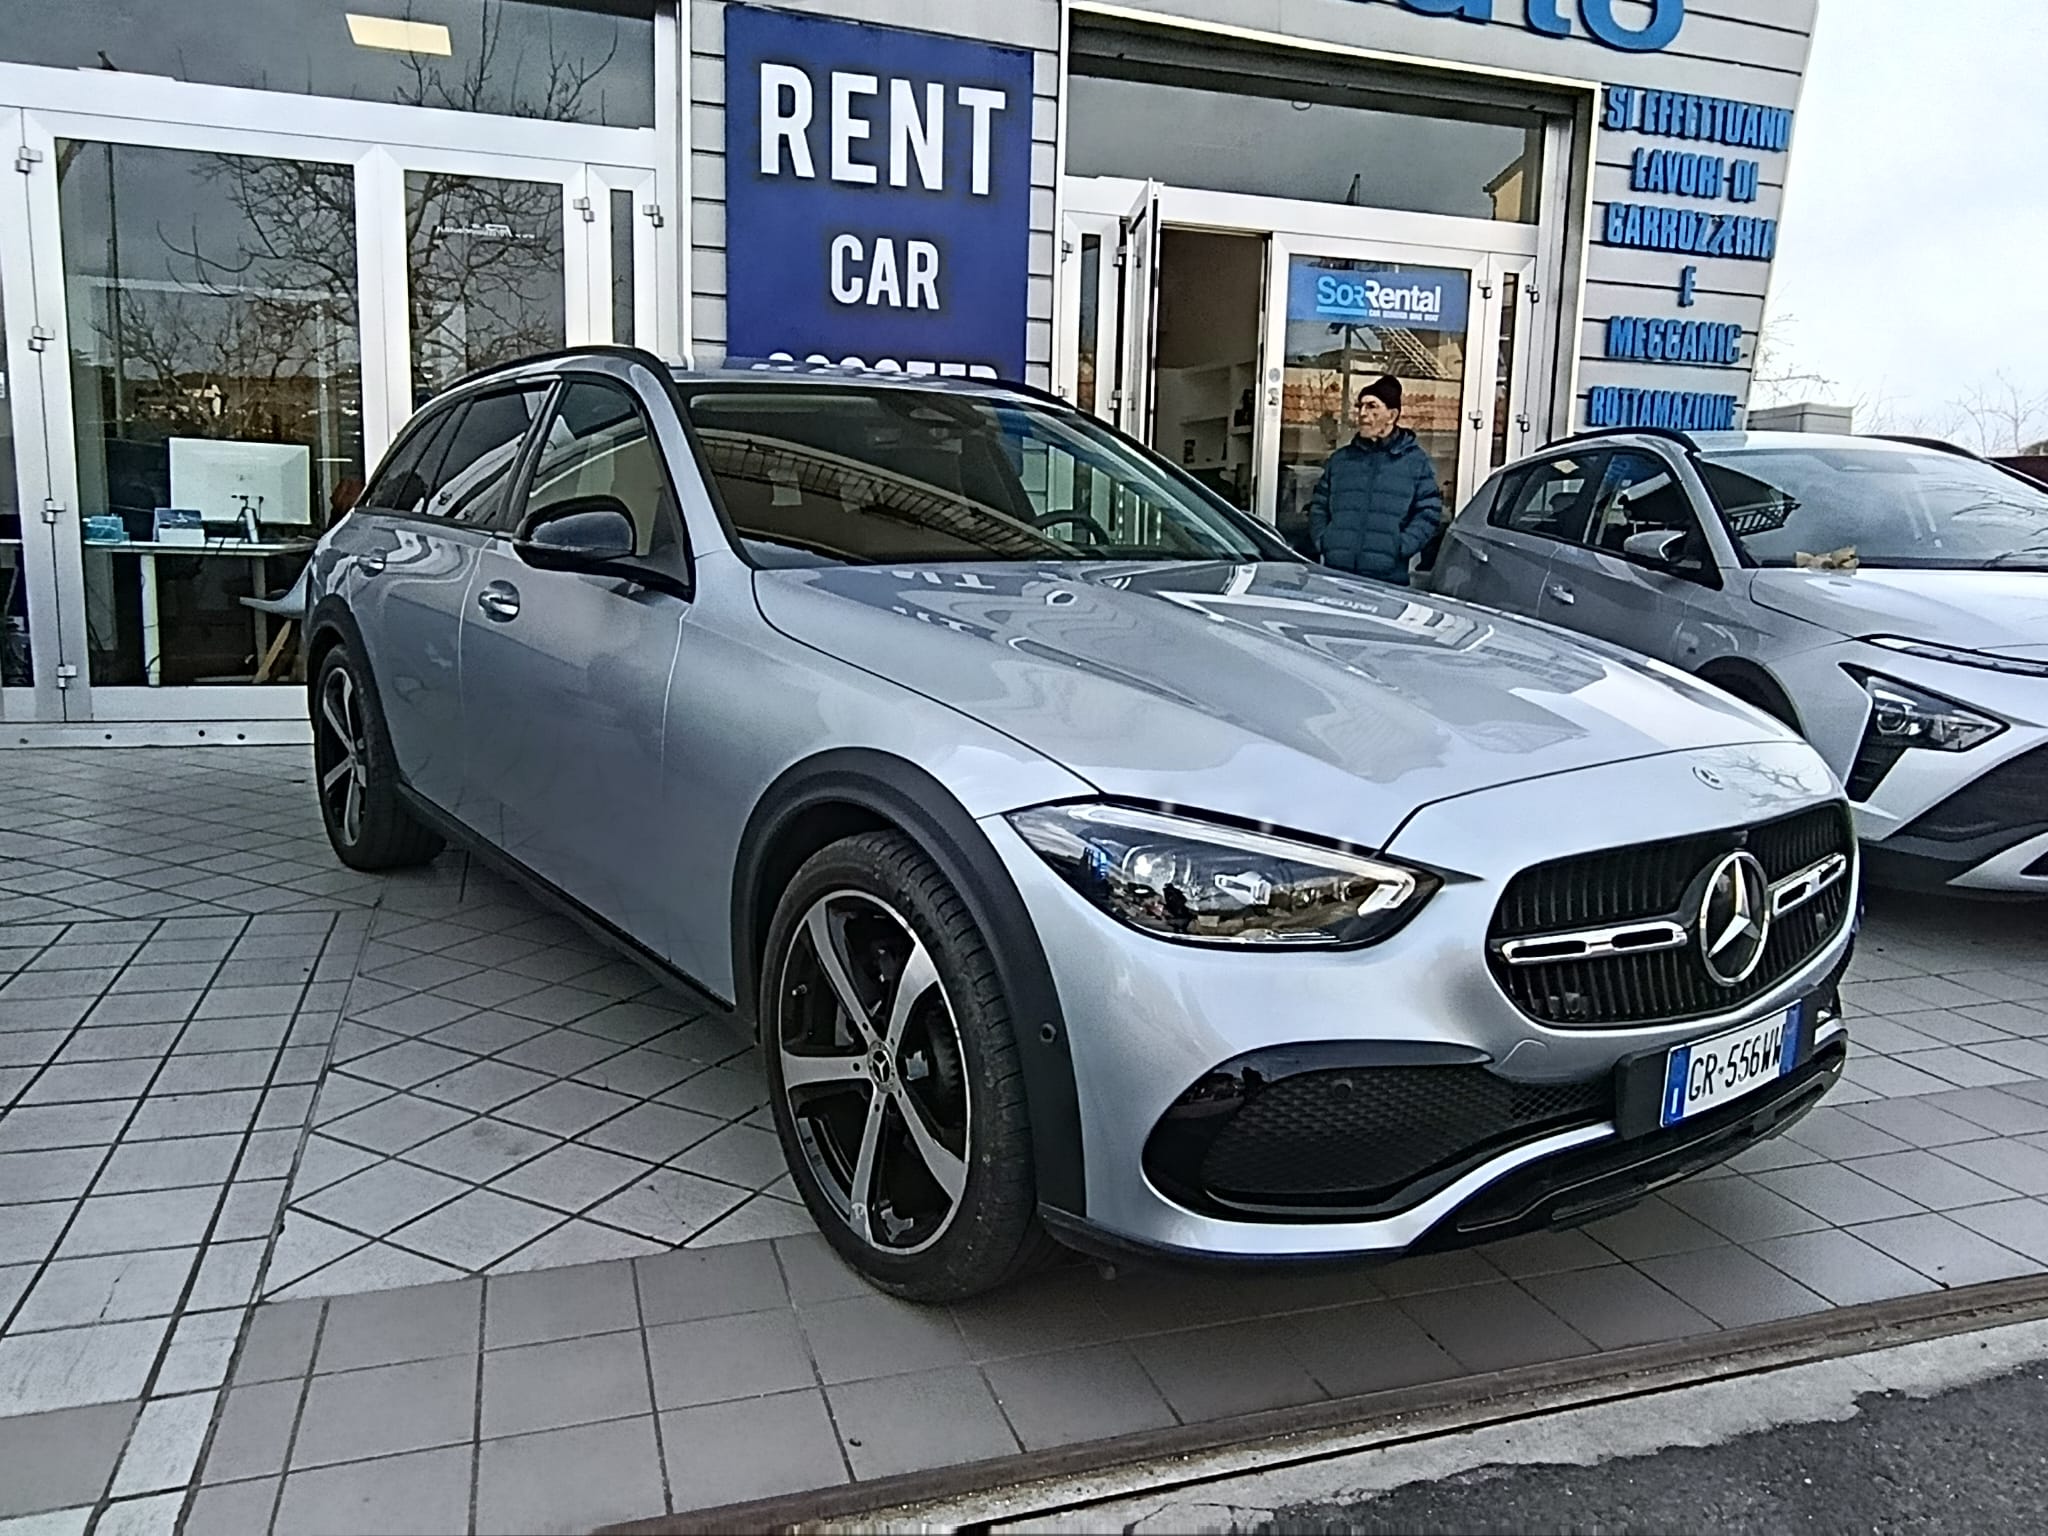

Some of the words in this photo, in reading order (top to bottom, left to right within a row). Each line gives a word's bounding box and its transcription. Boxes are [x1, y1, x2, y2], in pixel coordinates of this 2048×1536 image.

[760, 62, 1006, 196] RENT
[1606, 86, 1637, 131] SI
[1632, 147, 1724, 199] LAVORI
[1731, 159, 1759, 202] DI
[830, 234, 940, 310] CAR
[1681, 265, 1697, 307] E
[1589, 386, 1738, 431] ROTTAMAZIONE
